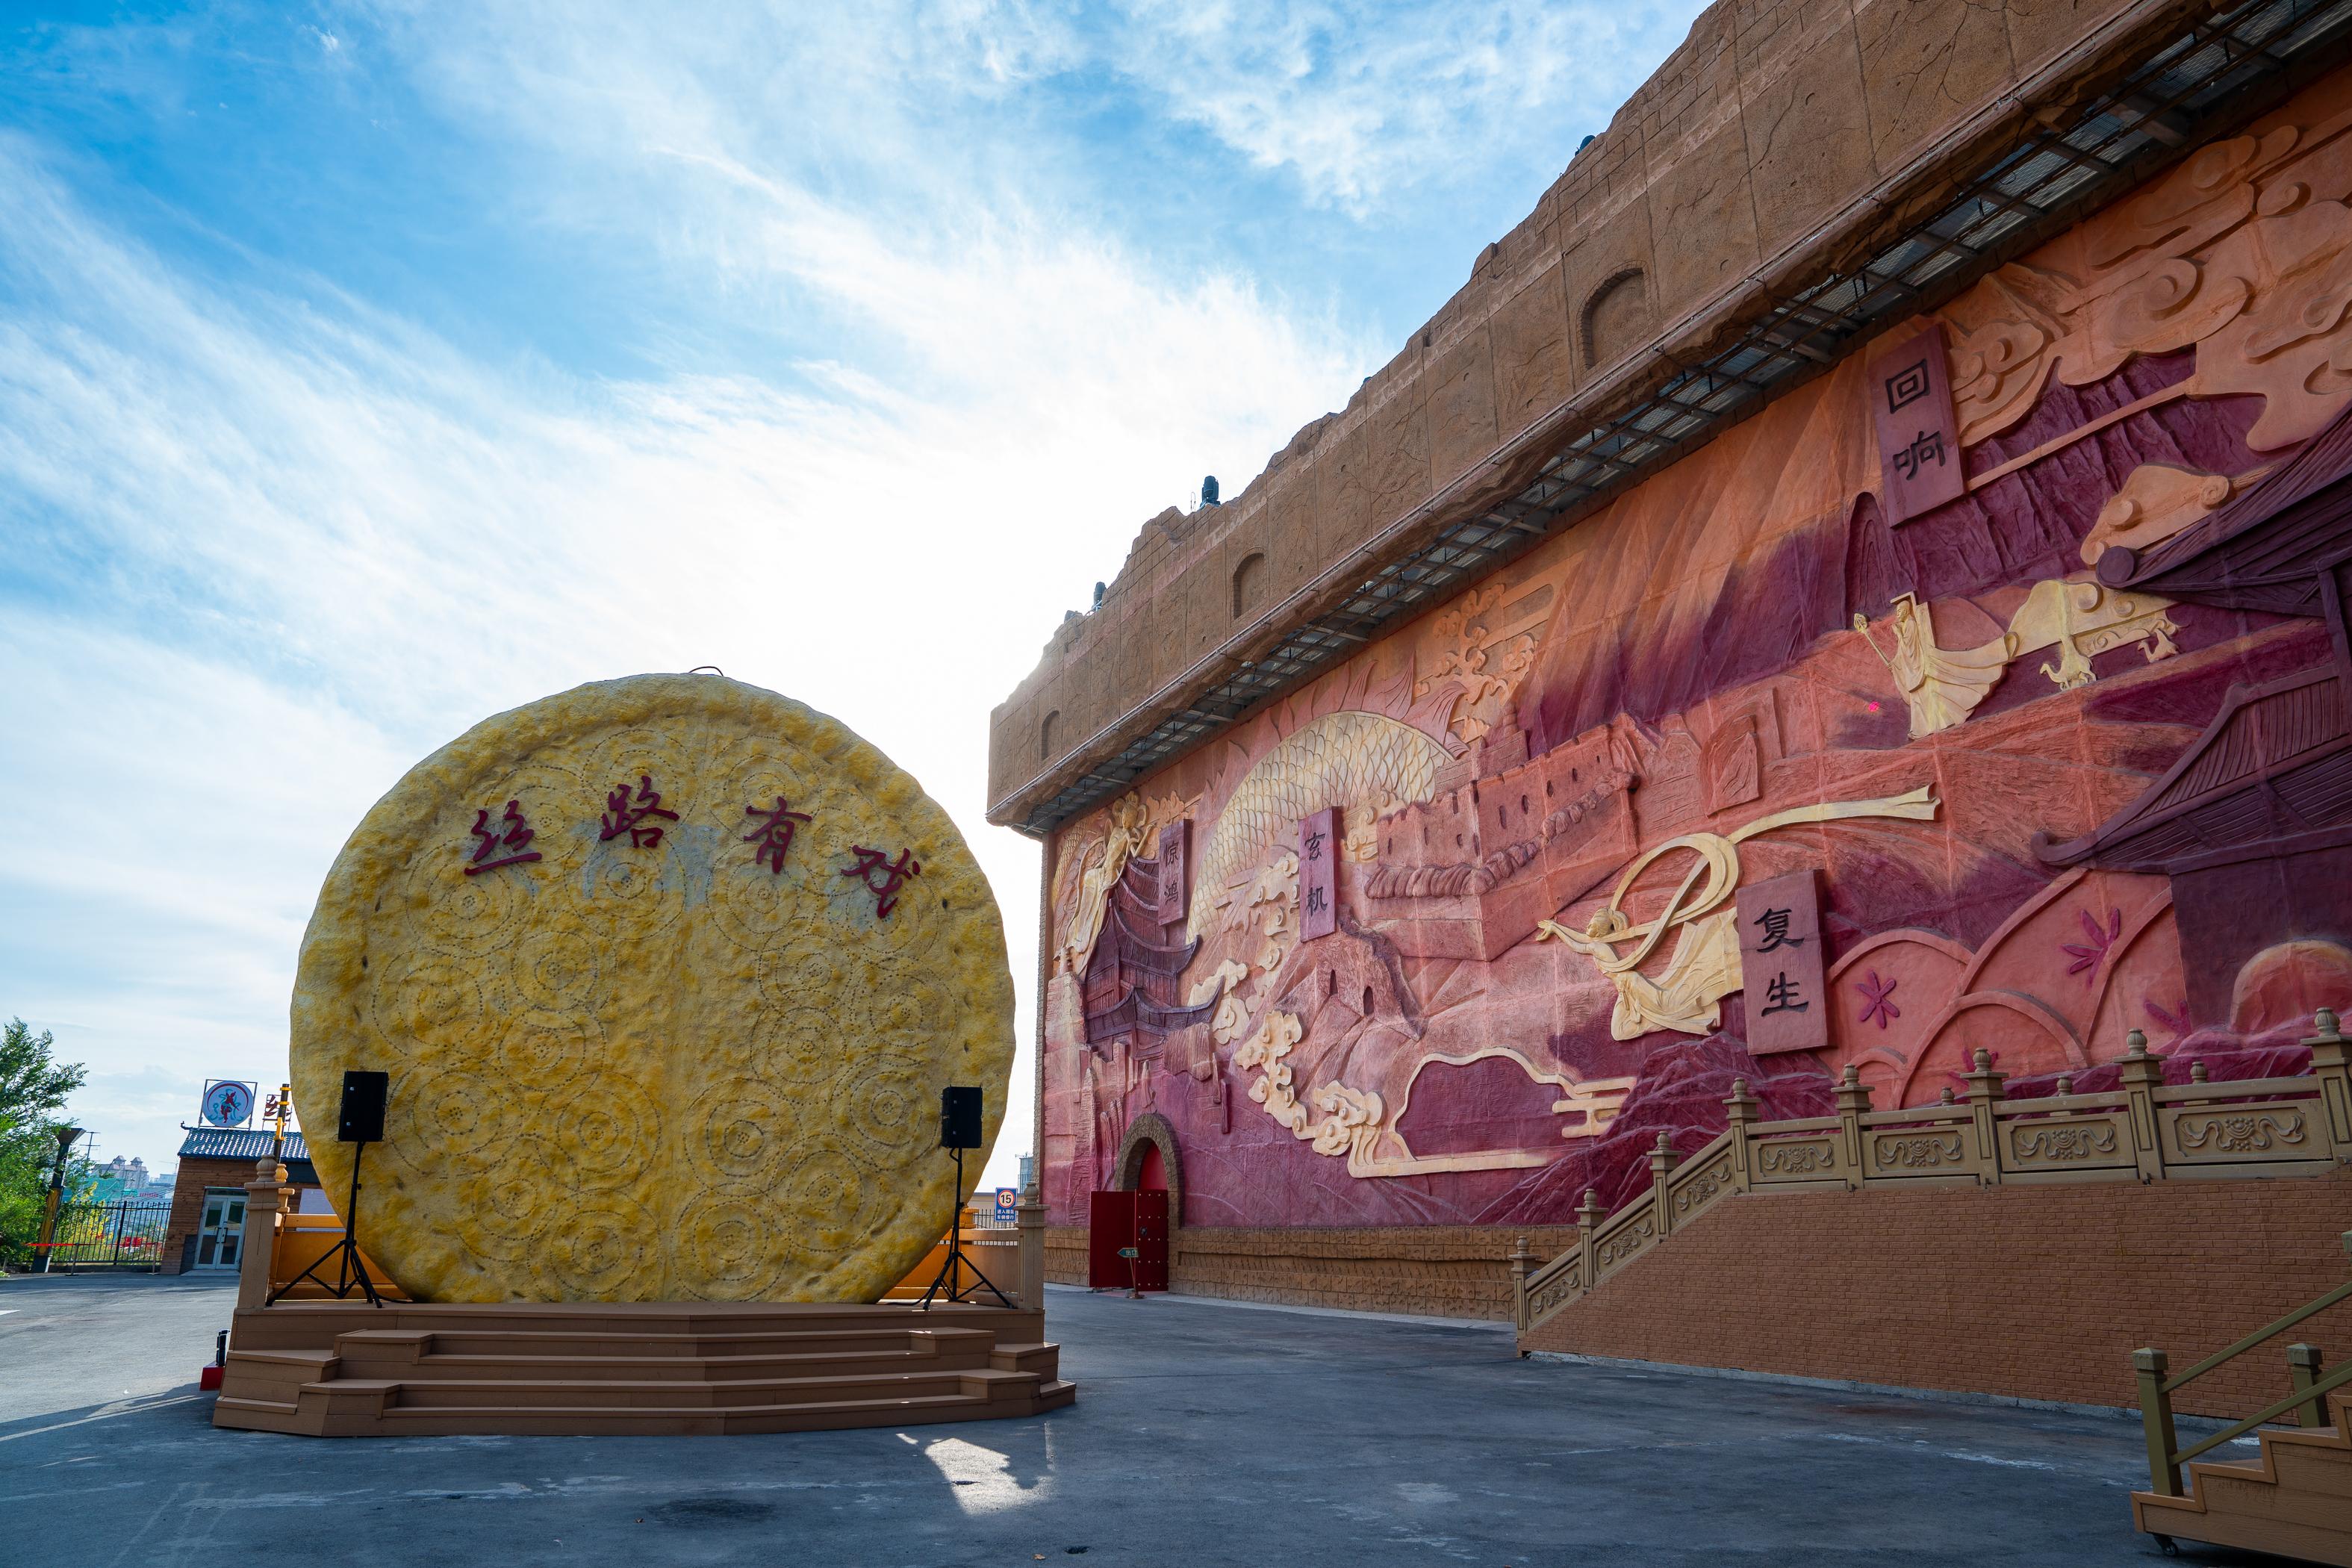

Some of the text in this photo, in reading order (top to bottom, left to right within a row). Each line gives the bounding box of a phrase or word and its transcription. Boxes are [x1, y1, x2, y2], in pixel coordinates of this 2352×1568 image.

[1885, 358, 1946, 480] 回响
[1164, 840, 1179, 903] 惊鸿
[1304, 832, 1328, 917] 玄机
[1753, 908, 1809, 1017] 复生
[1001, 1194, 1012, 1204] 15
